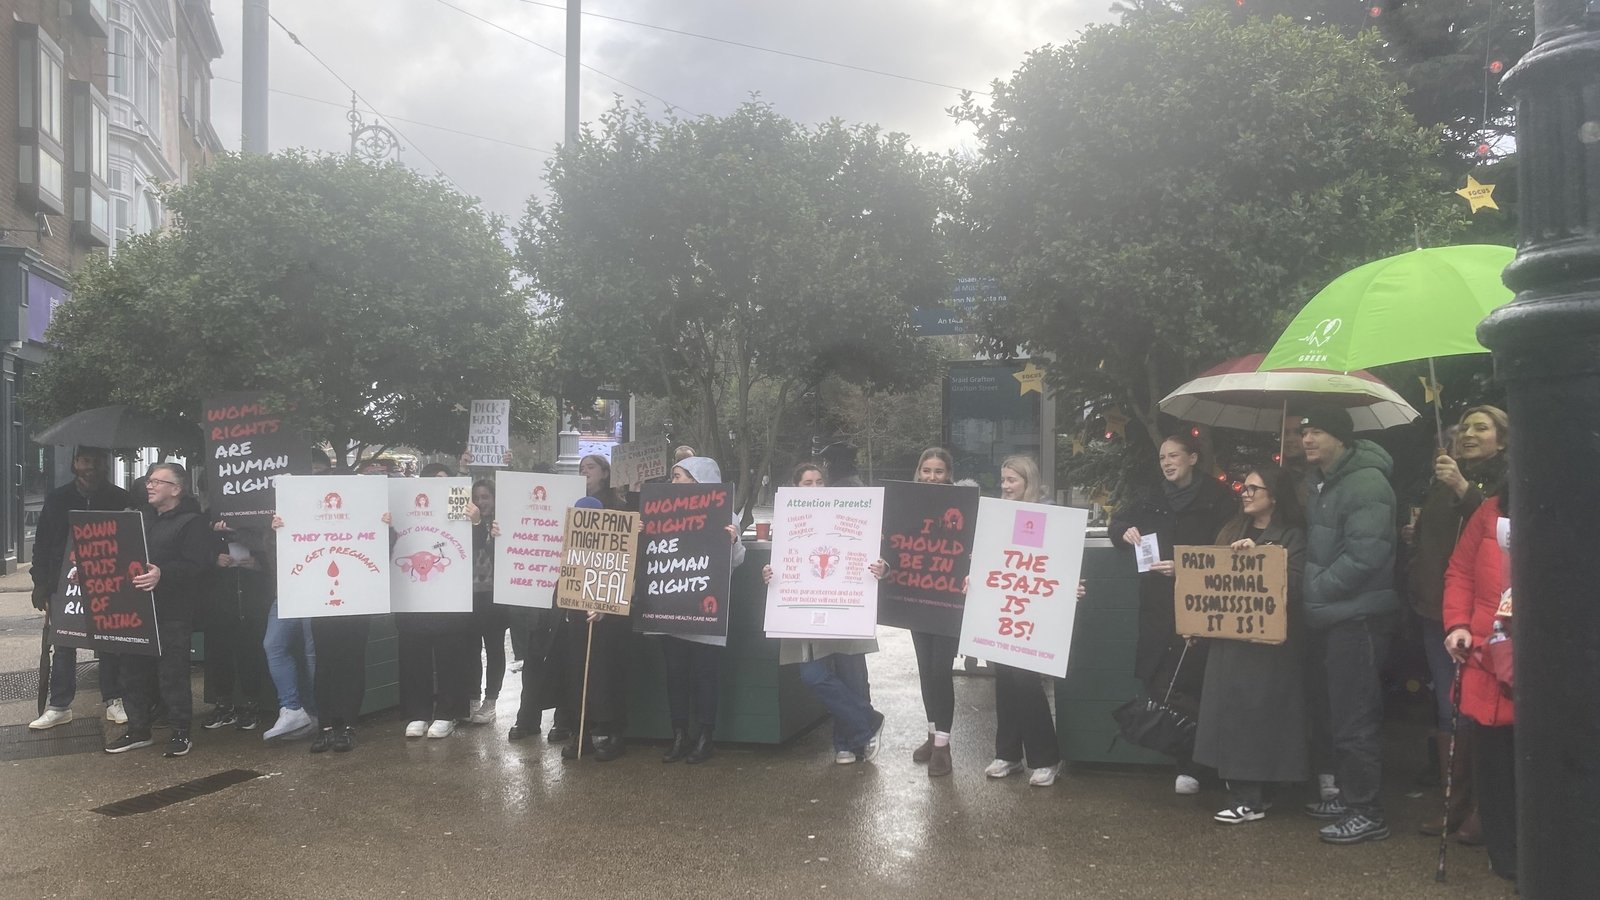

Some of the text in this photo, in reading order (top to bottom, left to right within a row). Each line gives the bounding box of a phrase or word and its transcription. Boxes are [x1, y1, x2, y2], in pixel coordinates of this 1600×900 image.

[1468, 188, 1490, 196] FOCUS
[1298, 354, 1328, 362] GREEN
[970, 376, 995, 384] Grafton
[472, 415, 502, 425] HALLS
[212, 419, 281, 440] RIGHTS
[470, 444, 506, 454] TRAINED
[471, 436, 498, 444] WELL
[215, 442, 252, 459] ARE
[219, 455, 289, 478] HUMAN
[636, 459, 662, 472] PAIN
[223, 474, 285, 495] RIGHT
[448, 496, 470, 505] BODY
[644, 490, 728, 514] WOMEN'S
[787, 498, 872, 509] Attention Parents!
[73, 520, 116, 540] DOWN
[414, 525, 440, 534] OVARY
[521, 517, 560, 526] IT TOOK
[574, 510, 633, 533] OUR PAIN
[646, 514, 708, 535] RIGHTS
[921, 518, 934, 534] I
[292, 532, 376, 542] THEY TOLD ME
[512, 532, 540, 542] MORE
[571, 530, 630, 552] MIGHT BE
[890, 534, 964, 556] SHOULD
[78, 540, 118, 558] WITH
[646, 538, 680, 555] ARE
[80, 558, 116, 576] THIS
[291, 546, 380, 576] TO GET PREGNANT
[514, 562, 524, 570] TO
[528, 564, 548, 572] GET
[567, 550, 630, 572] INVISIBLE
[647, 556, 710, 575] HUMAN
[899, 552, 954, 574] BE IN
[1003, 550, 1050, 573] THE
[1182, 552, 1266, 573] PAIN ISNT
[561, 566, 577, 578] BUT
[86, 576, 124, 594] SORT
[510, 577, 533, 586] HERE
[566, 568, 628, 604] ITS REAL
[648, 576, 710, 596] RIGHTS
[986, 570, 1059, 597] ESAIS
[1204, 574, 1269, 593] NORMAL
[90, 596, 110, 612] OF
[560, 598, 621, 612] BREAK THE SILENCE!
[1000, 594, 1030, 615] IS
[1185, 594, 1276, 615] DISMISSING
[94, 613, 142, 630] THING
[998, 616, 1034, 641] BS!
[1207, 614, 1224, 632] IT
[974, 638, 1056, 660] AMEND THE SCHEME NOW
